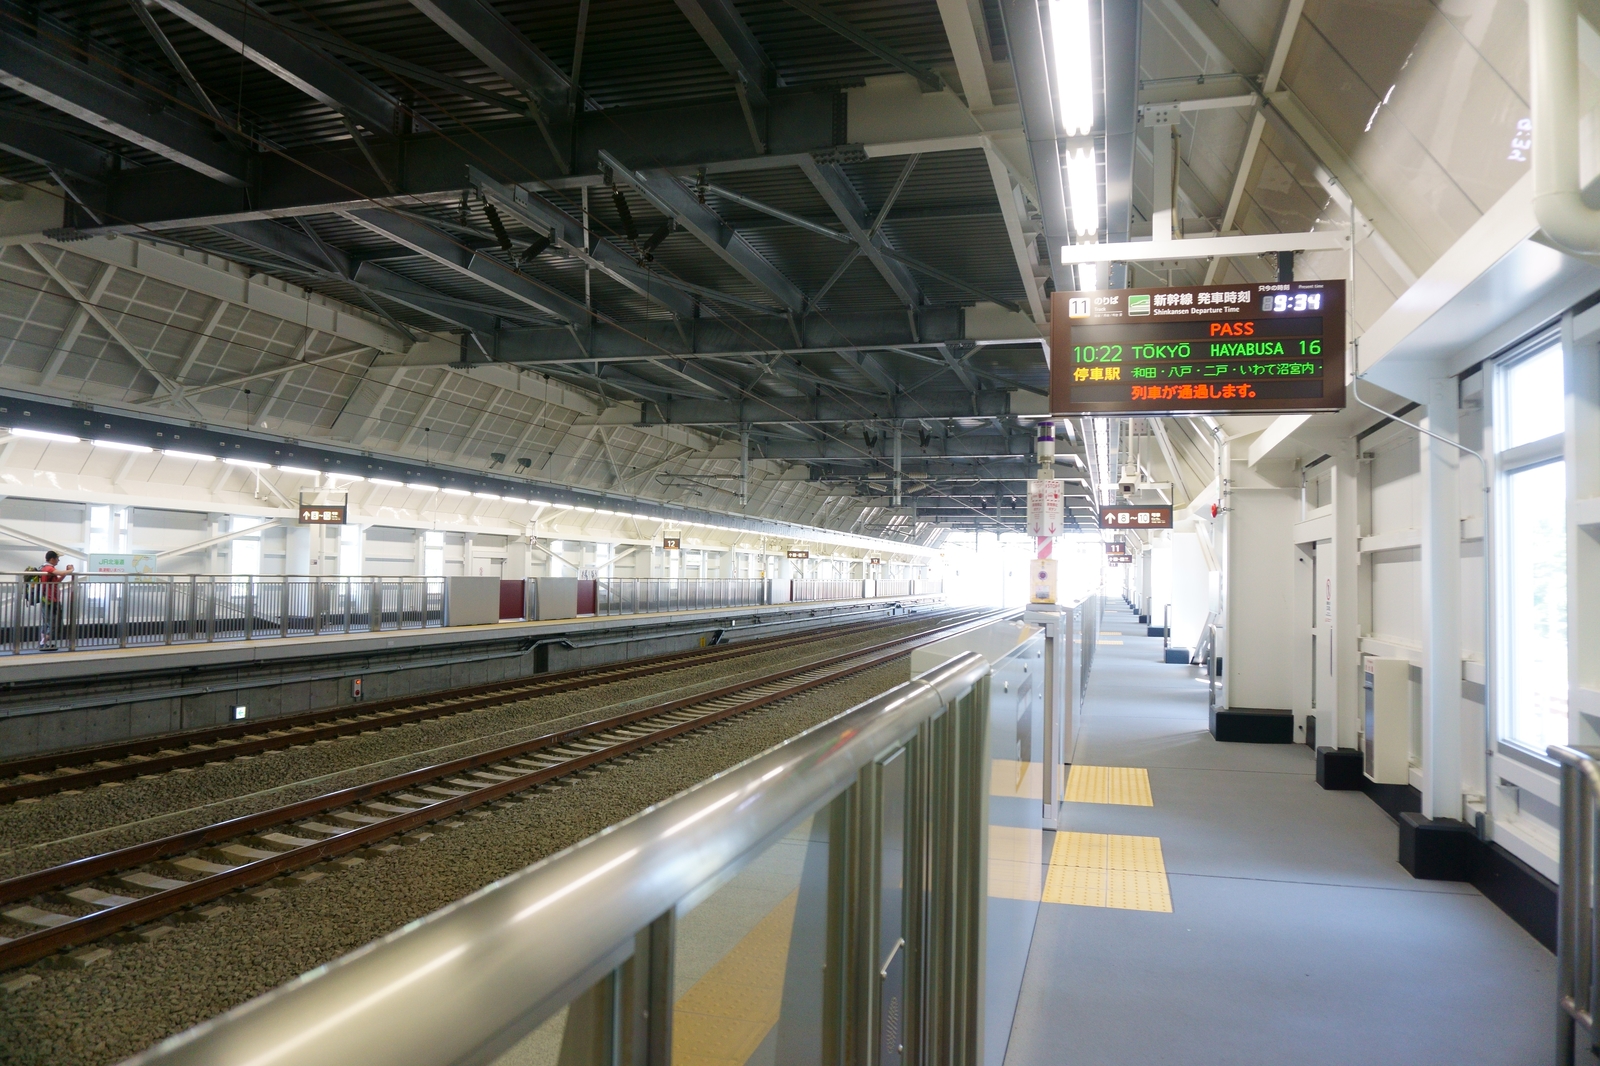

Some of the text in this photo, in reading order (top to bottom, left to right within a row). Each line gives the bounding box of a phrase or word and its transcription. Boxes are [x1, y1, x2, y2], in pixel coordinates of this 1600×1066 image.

[1094, 296, 1119, 305] のりば
[1153, 290, 1251, 307] 新幹線 発車時刻
[1273, 293, 1321, 312] 9:34
[1072, 300, 1087, 314] 11
[1153, 308, 1189, 316] Shinkansen
[1190, 307, 1223, 316] Departure
[1210, 322, 1254, 337] PASS
[1073, 339, 1321, 363] 10:22 TŌKYŌ HAYABUSA 16
[1073, 367, 1121, 382] 停車駅
[1131, 383, 1257, 401] 列車が通過します。
